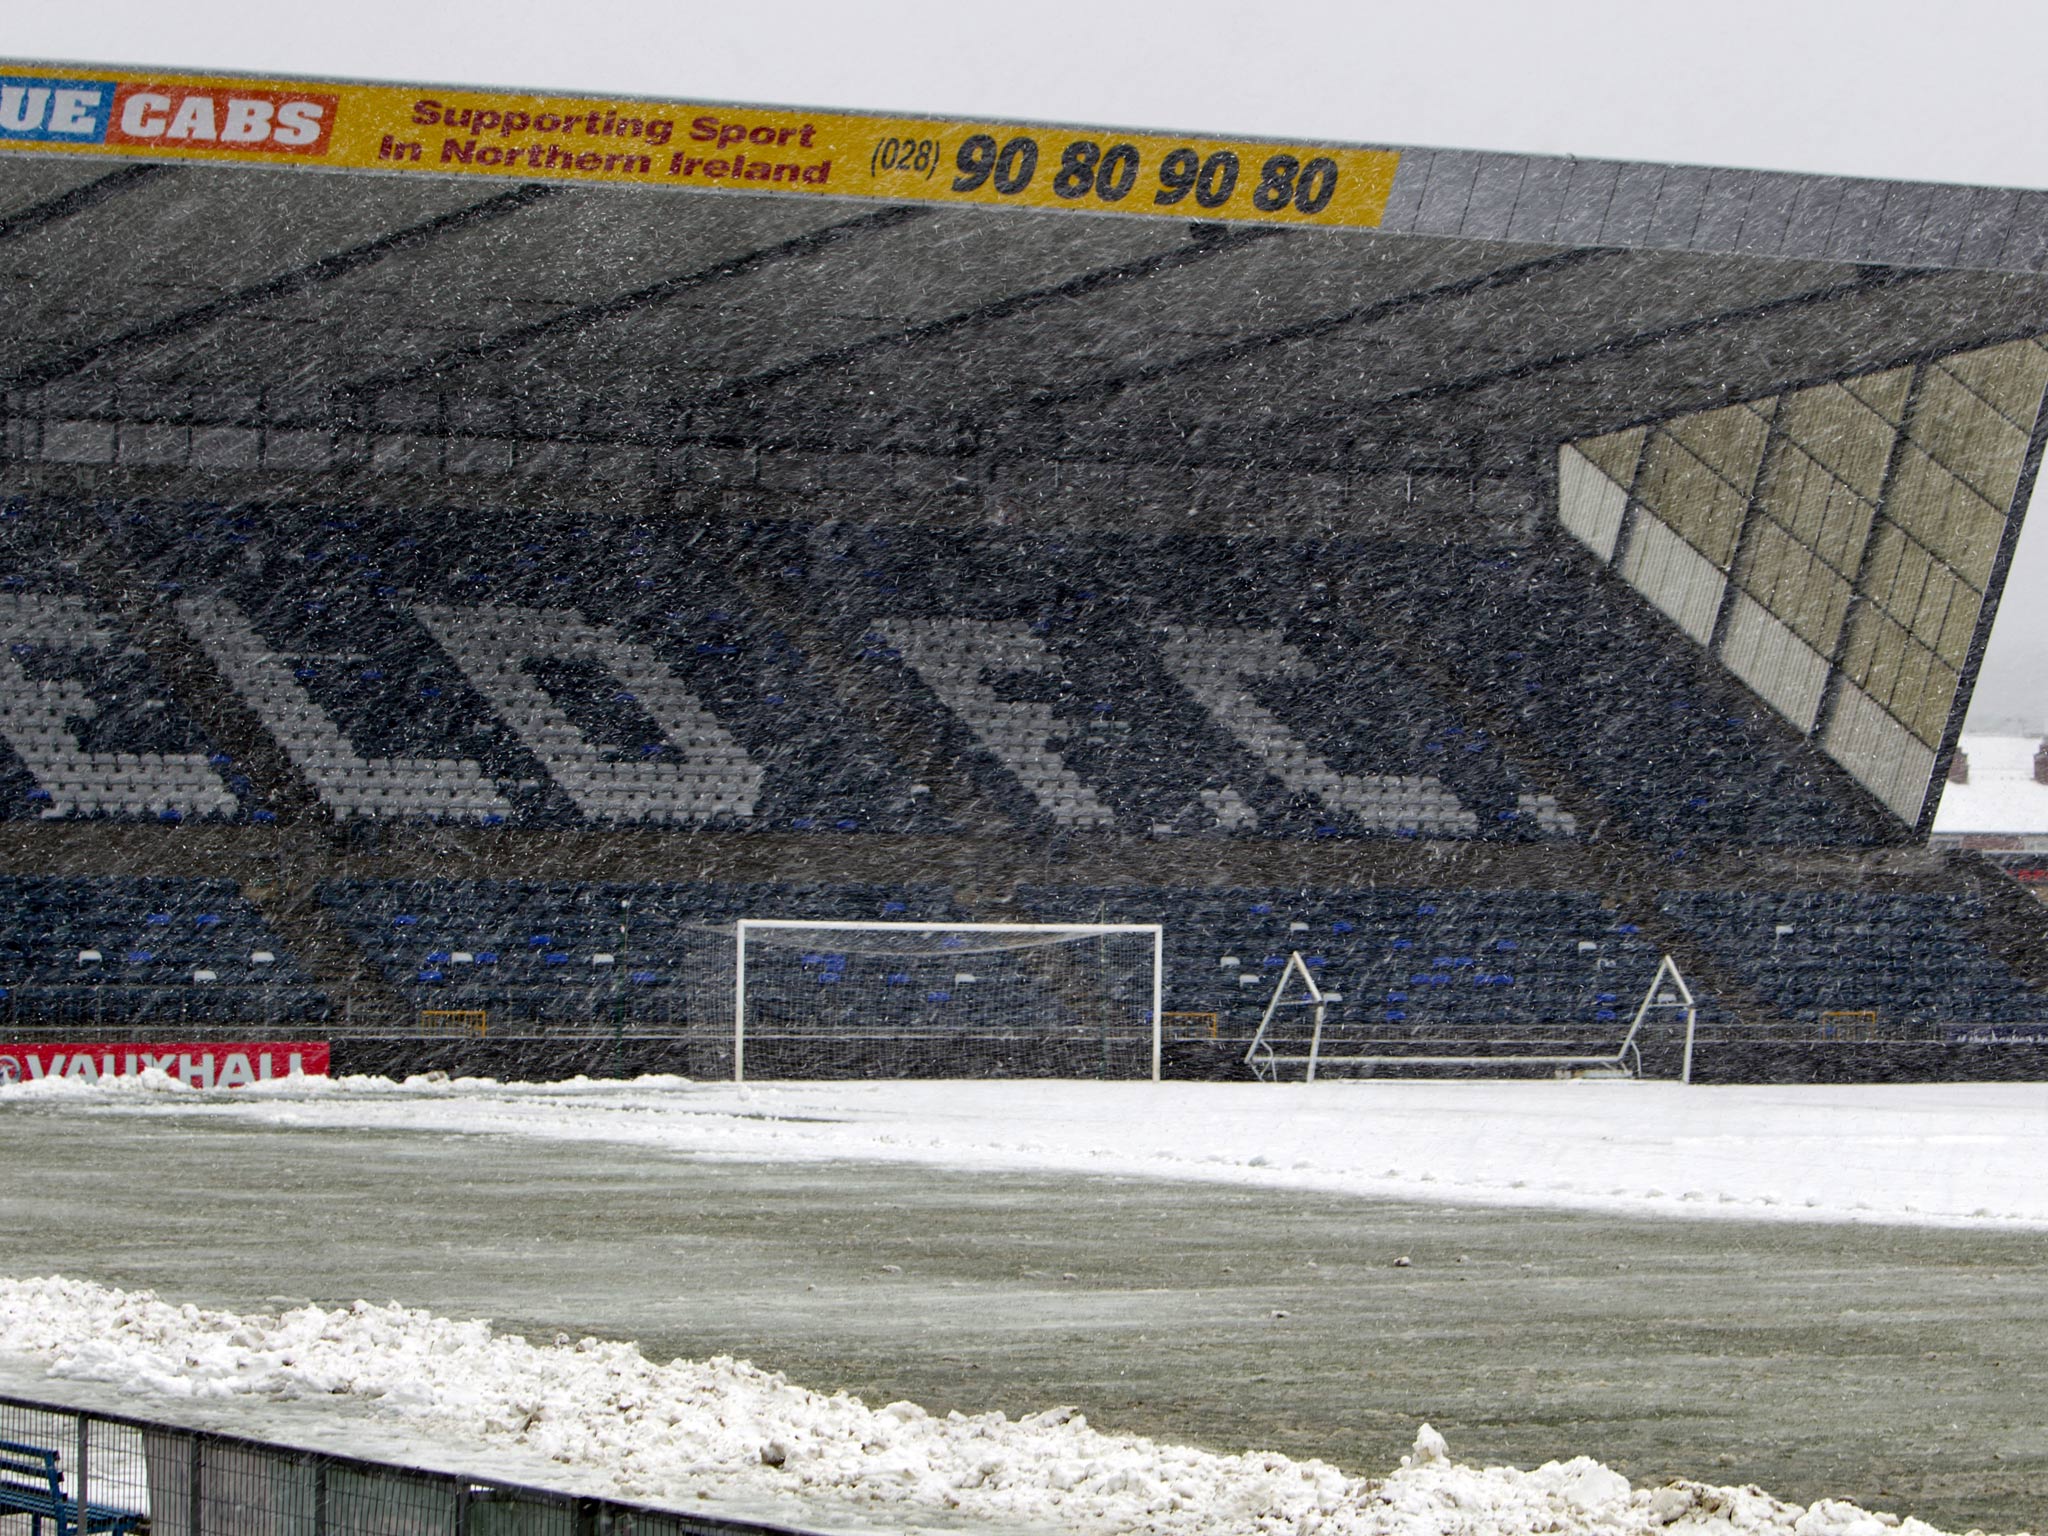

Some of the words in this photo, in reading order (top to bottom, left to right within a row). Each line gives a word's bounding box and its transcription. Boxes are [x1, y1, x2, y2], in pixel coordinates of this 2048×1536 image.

[120, 93, 325, 146] CABS
[412, 99, 674, 146] Supporting
[688, 116, 817, 150] Sport
[378, 134, 422, 162] In
[440, 137, 651, 174] Northern
[668, 151, 832, 185] Ireland
[871, 137, 940, 181] (028)
[951, 133, 1039, 196] 90
[1053, 140, 1140, 203] 80
[1154, 147, 1240, 209] 90
[1253, 154, 1338, 215] 80
